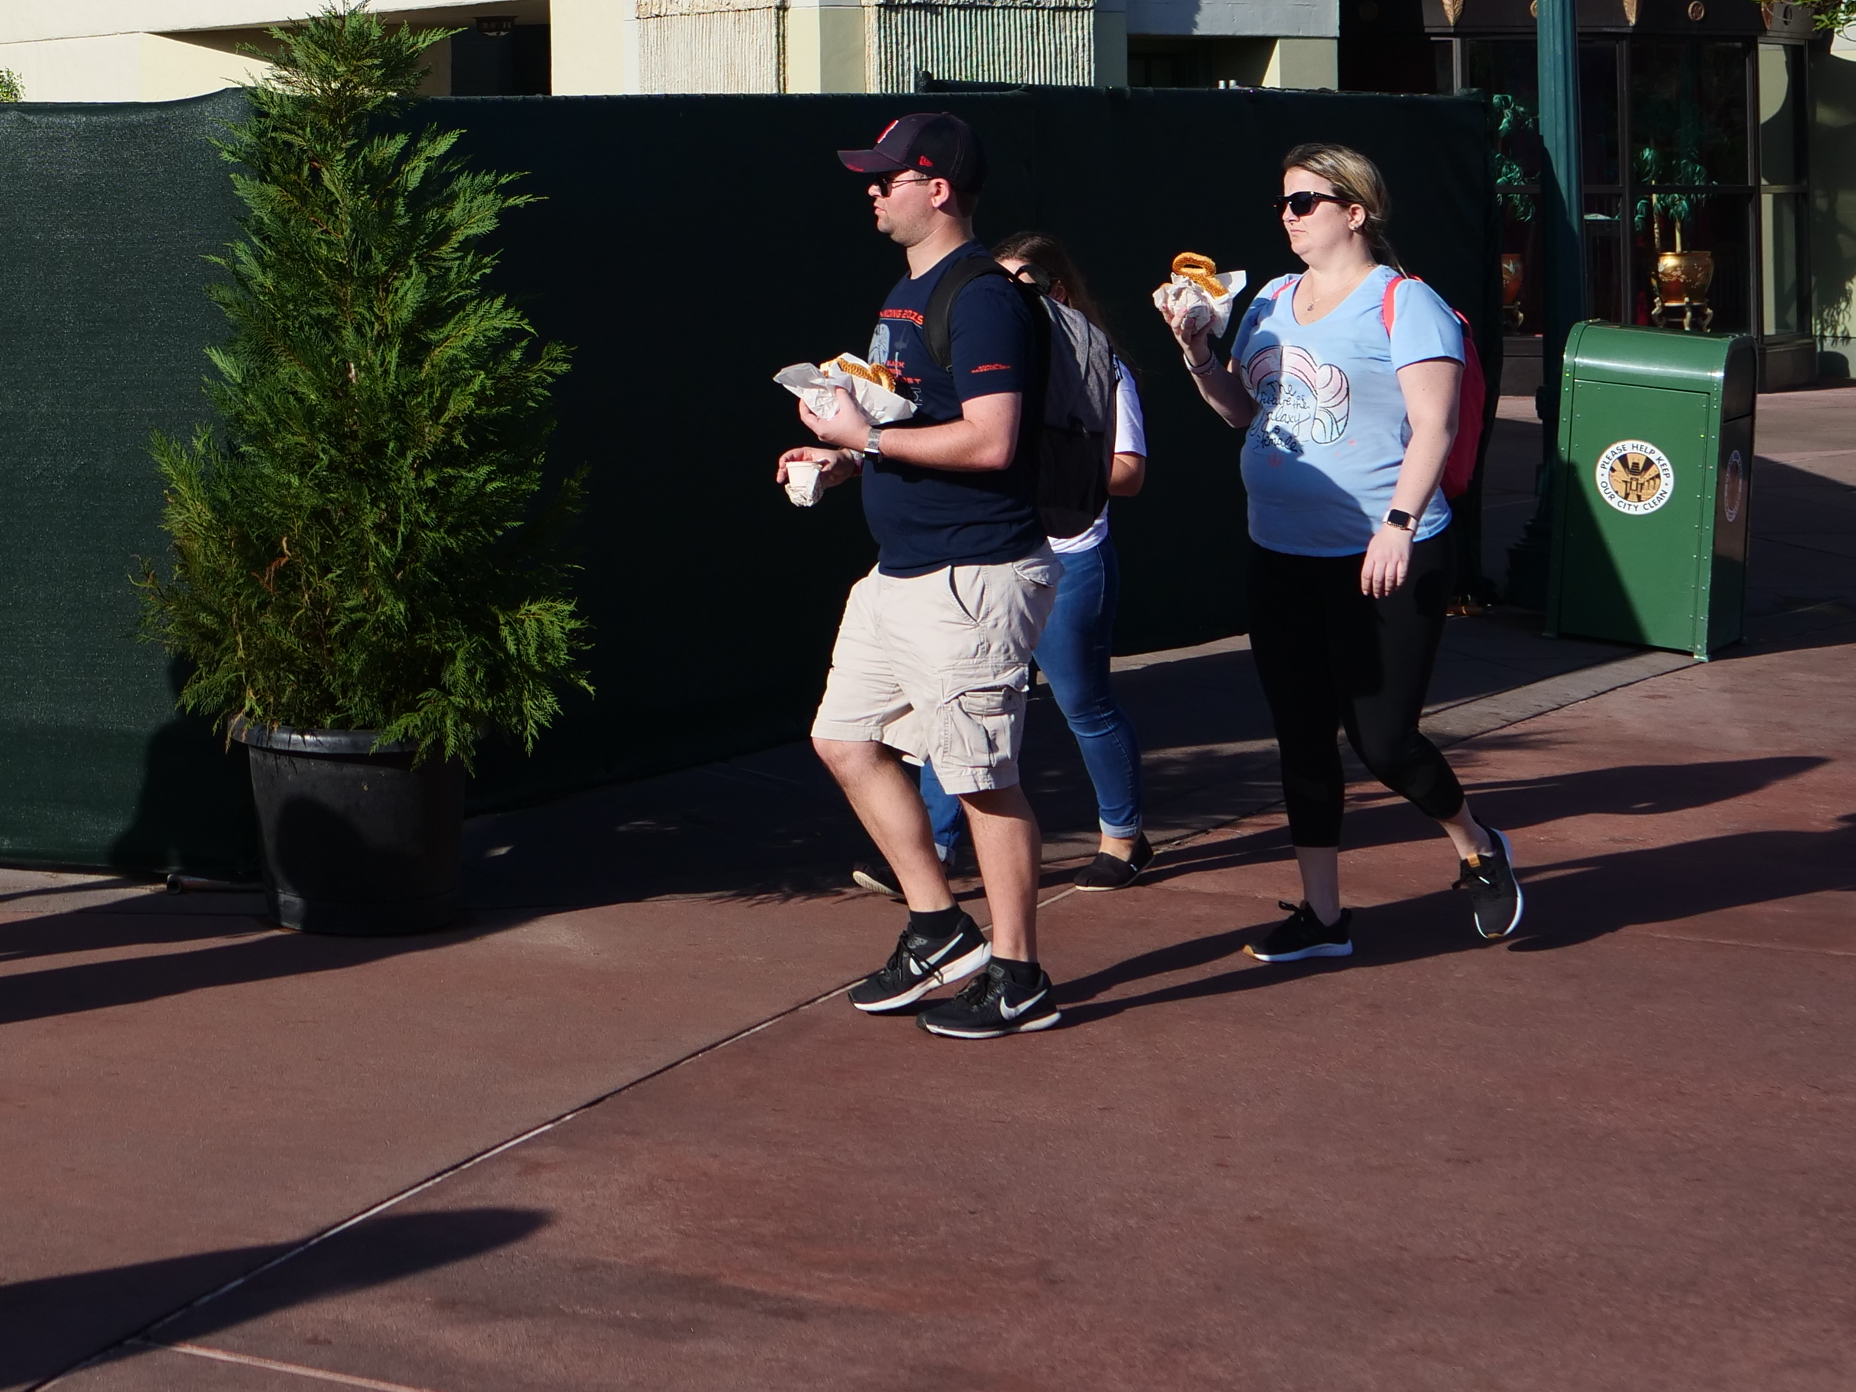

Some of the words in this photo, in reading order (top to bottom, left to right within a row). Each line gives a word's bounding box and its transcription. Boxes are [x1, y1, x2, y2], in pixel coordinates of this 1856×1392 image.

[1266, 380, 1297, 396] The
[1600, 444, 1627, 470] PLEASE
[1631, 443, 1656, 455] HELP
[1655, 456, 1671, 478] KEEP
[1600, 480, 1616, 501] OUR
[1617, 500, 1639, 511] CITY
[1642, 489, 1668, 511] CLEAN
